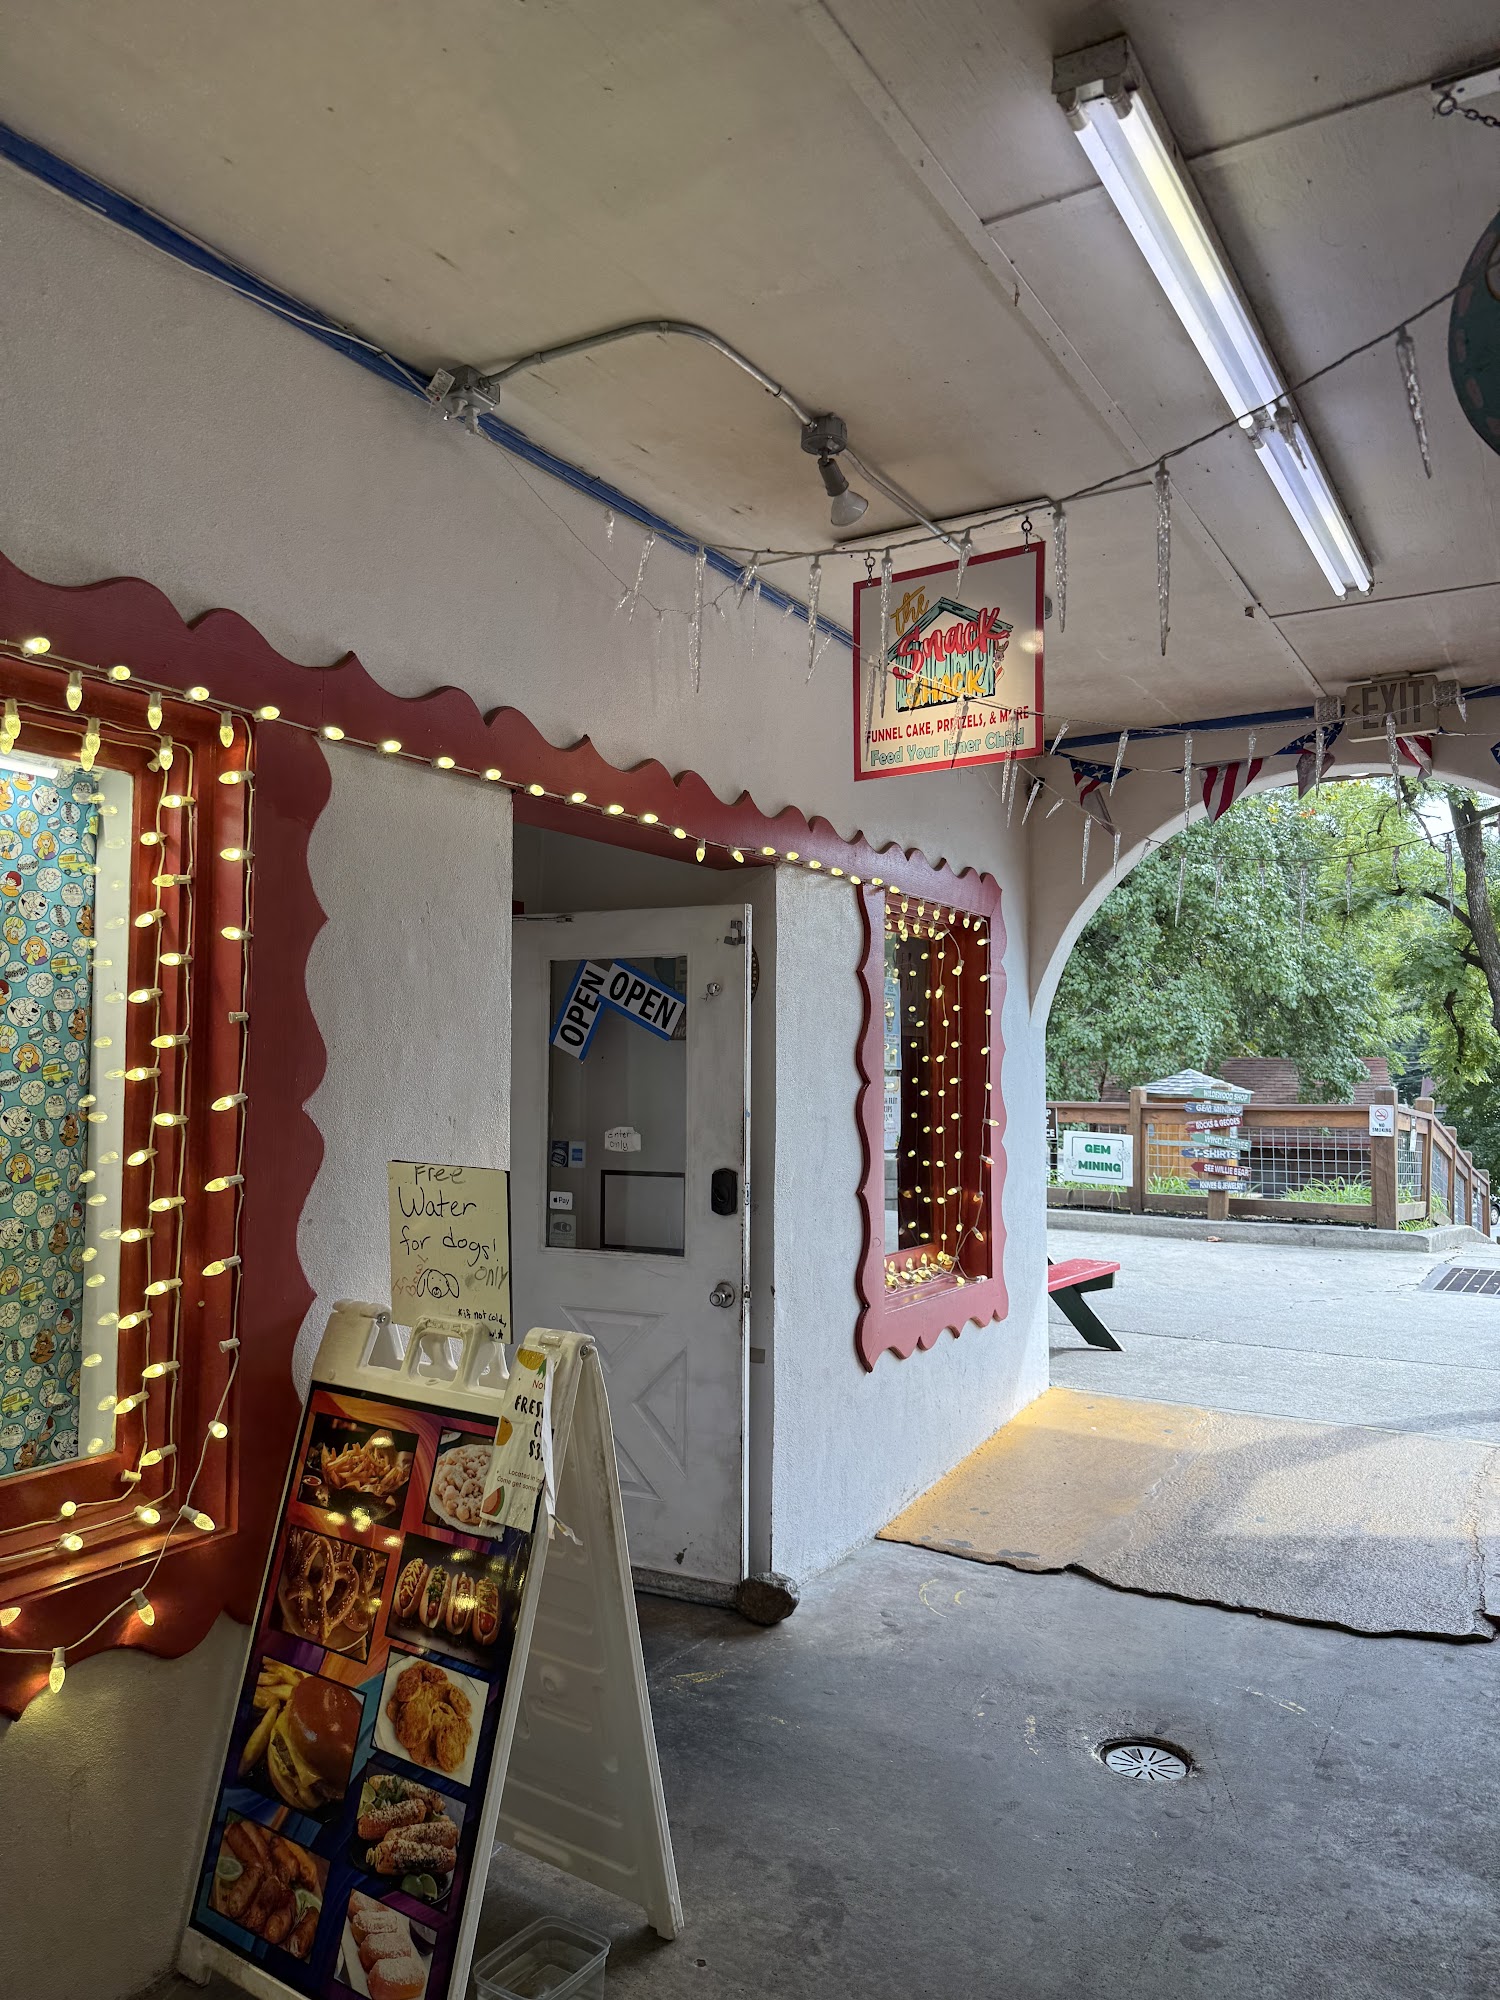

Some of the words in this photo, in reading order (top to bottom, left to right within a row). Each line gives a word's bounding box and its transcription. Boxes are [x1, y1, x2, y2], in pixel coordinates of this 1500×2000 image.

[1362, 680, 1424, 730] EXIT
[866, 726, 903, 743] FUNNEL
[906, 722, 934, 737] CAKE,
[990, 711, 997, 724] &
[871, 746, 903, 766] Feed
[907, 743, 939, 762] Your
[944, 739, 981, 757] Inner
[560, 970, 605, 1047] OPEN
[610, 971, 677, 1030] OPEN
[1234, 1093, 1248, 1101] SHOP
[1204, 1135, 1221, 1144] WIND
[1084, 1144, 1111, 1154] GEM
[1078, 1160, 1122, 1172] MINING
[1204, 1164, 1214, 1172] SEE
[415, 1165, 466, 1185] Free
[398, 1186, 477, 1217] Water
[558, 1196, 570, 1206] Pay
[400, 1225, 431, 1255] for
[442, 1226, 499, 1267] dogs!
[497, 1475, 511, 1485] Come
[508, 1469, 531, 1480] Located
